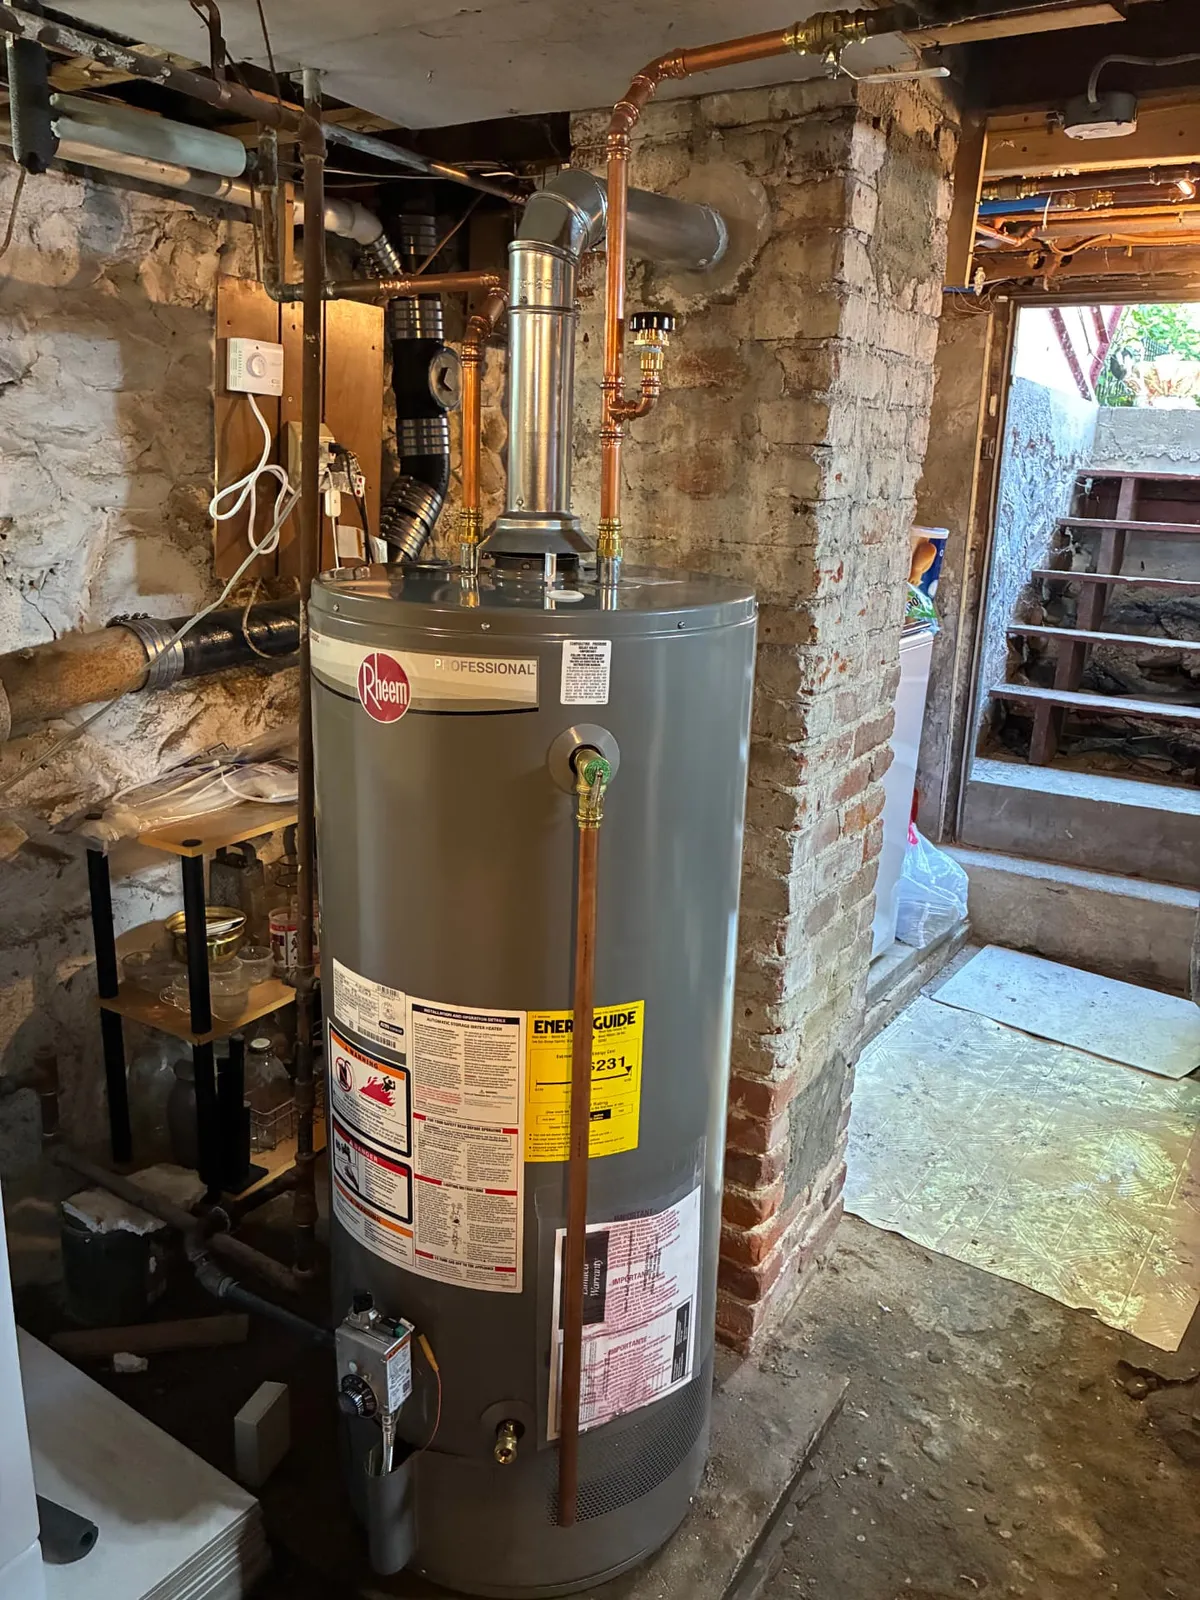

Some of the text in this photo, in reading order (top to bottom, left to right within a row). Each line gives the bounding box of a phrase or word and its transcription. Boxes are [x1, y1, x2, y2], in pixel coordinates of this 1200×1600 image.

[434, 658, 535, 675] POFESSIONAL
[363, 652, 407, 711] Rheem
[426, 1017, 451, 1026] AUTOMATIC
[450, 1021, 470, 1029] STORAGE
[534, 1019, 574, 1034] ENER
[349, 1048, 379, 1070] WARNING
[590, 1261, 604, 1297] Warranty
